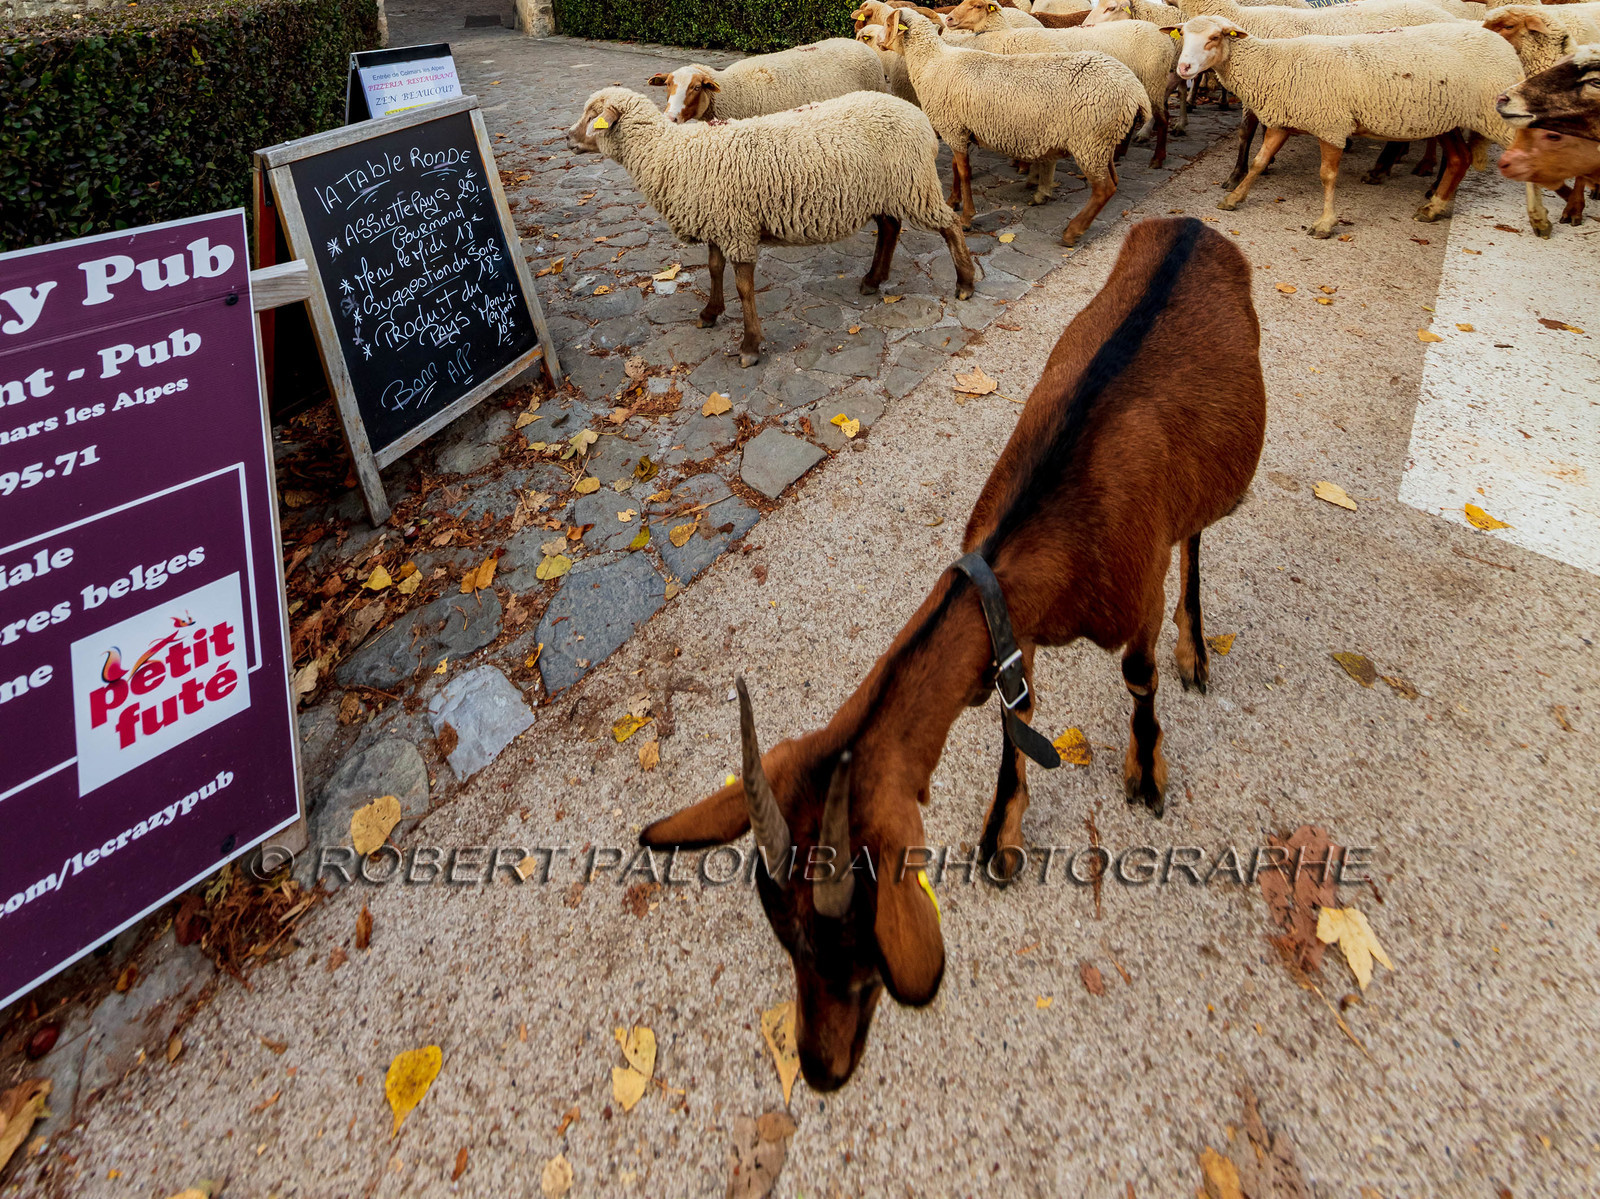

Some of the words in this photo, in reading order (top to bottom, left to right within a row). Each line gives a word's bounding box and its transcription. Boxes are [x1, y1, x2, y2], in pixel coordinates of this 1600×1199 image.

[368, 80, 403, 92] PIZZERIA
[406, 72, 454, 85] RESTAURANT
[376, 95, 397, 106] ZEN
[402, 85, 454, 101] BEAUCOUP
[0, 281, 58, 335] y
[77, 237, 235, 306] Pub
[97, 328, 202, 379] Pub
[65, 403, 106, 425] les
[112, 378, 189, 412] Alpes
[0, 445, 100, 496] 95.71
[0, 601, 71, 647] res
[80, 546, 206, 611] belges
[89, 621, 235, 730] petit
[115, 660, 238, 750] futé
[0, 770, 234, 919] om/lecrazypub
